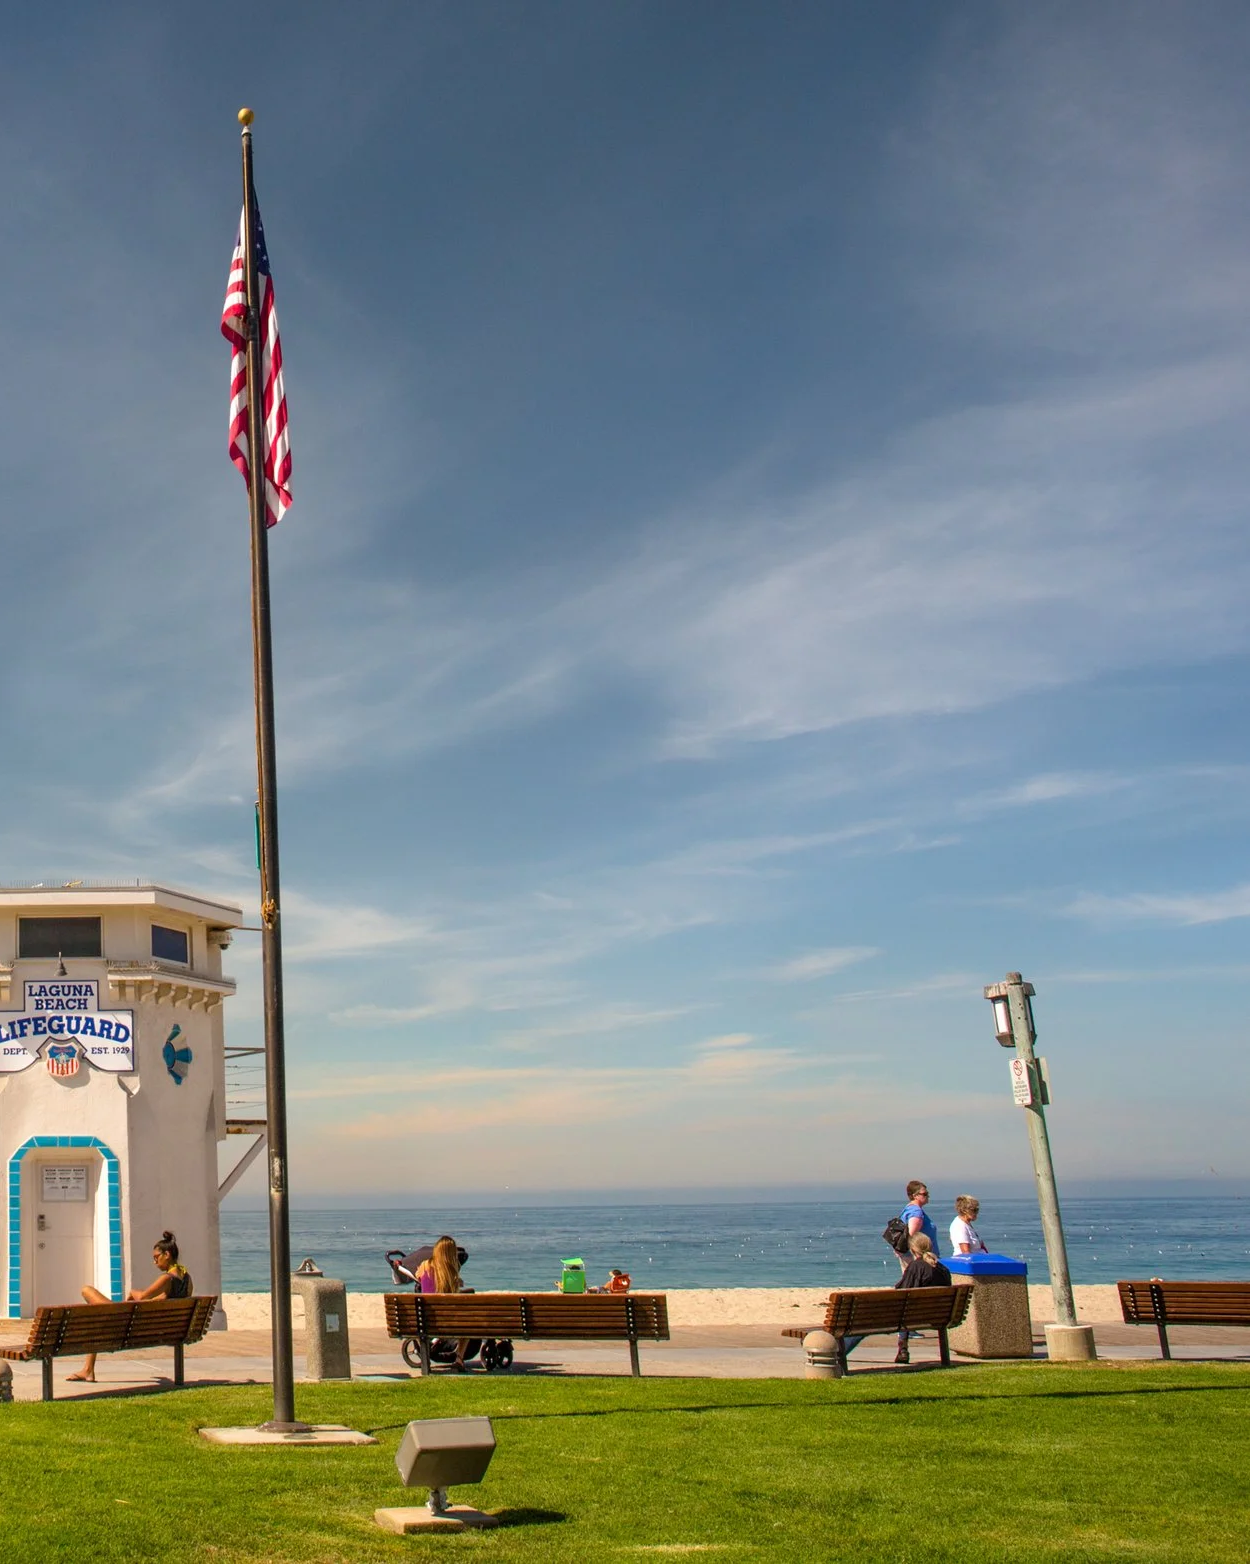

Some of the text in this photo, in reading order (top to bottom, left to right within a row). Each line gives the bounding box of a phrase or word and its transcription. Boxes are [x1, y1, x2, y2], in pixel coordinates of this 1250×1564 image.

[28, 985, 94, 997] LAGUNA
[34, 999, 88, 1011] BEACH
[3, 1047, 28, 1055] DEPT.
[91, 1046, 130, 1055] EST. 1929
